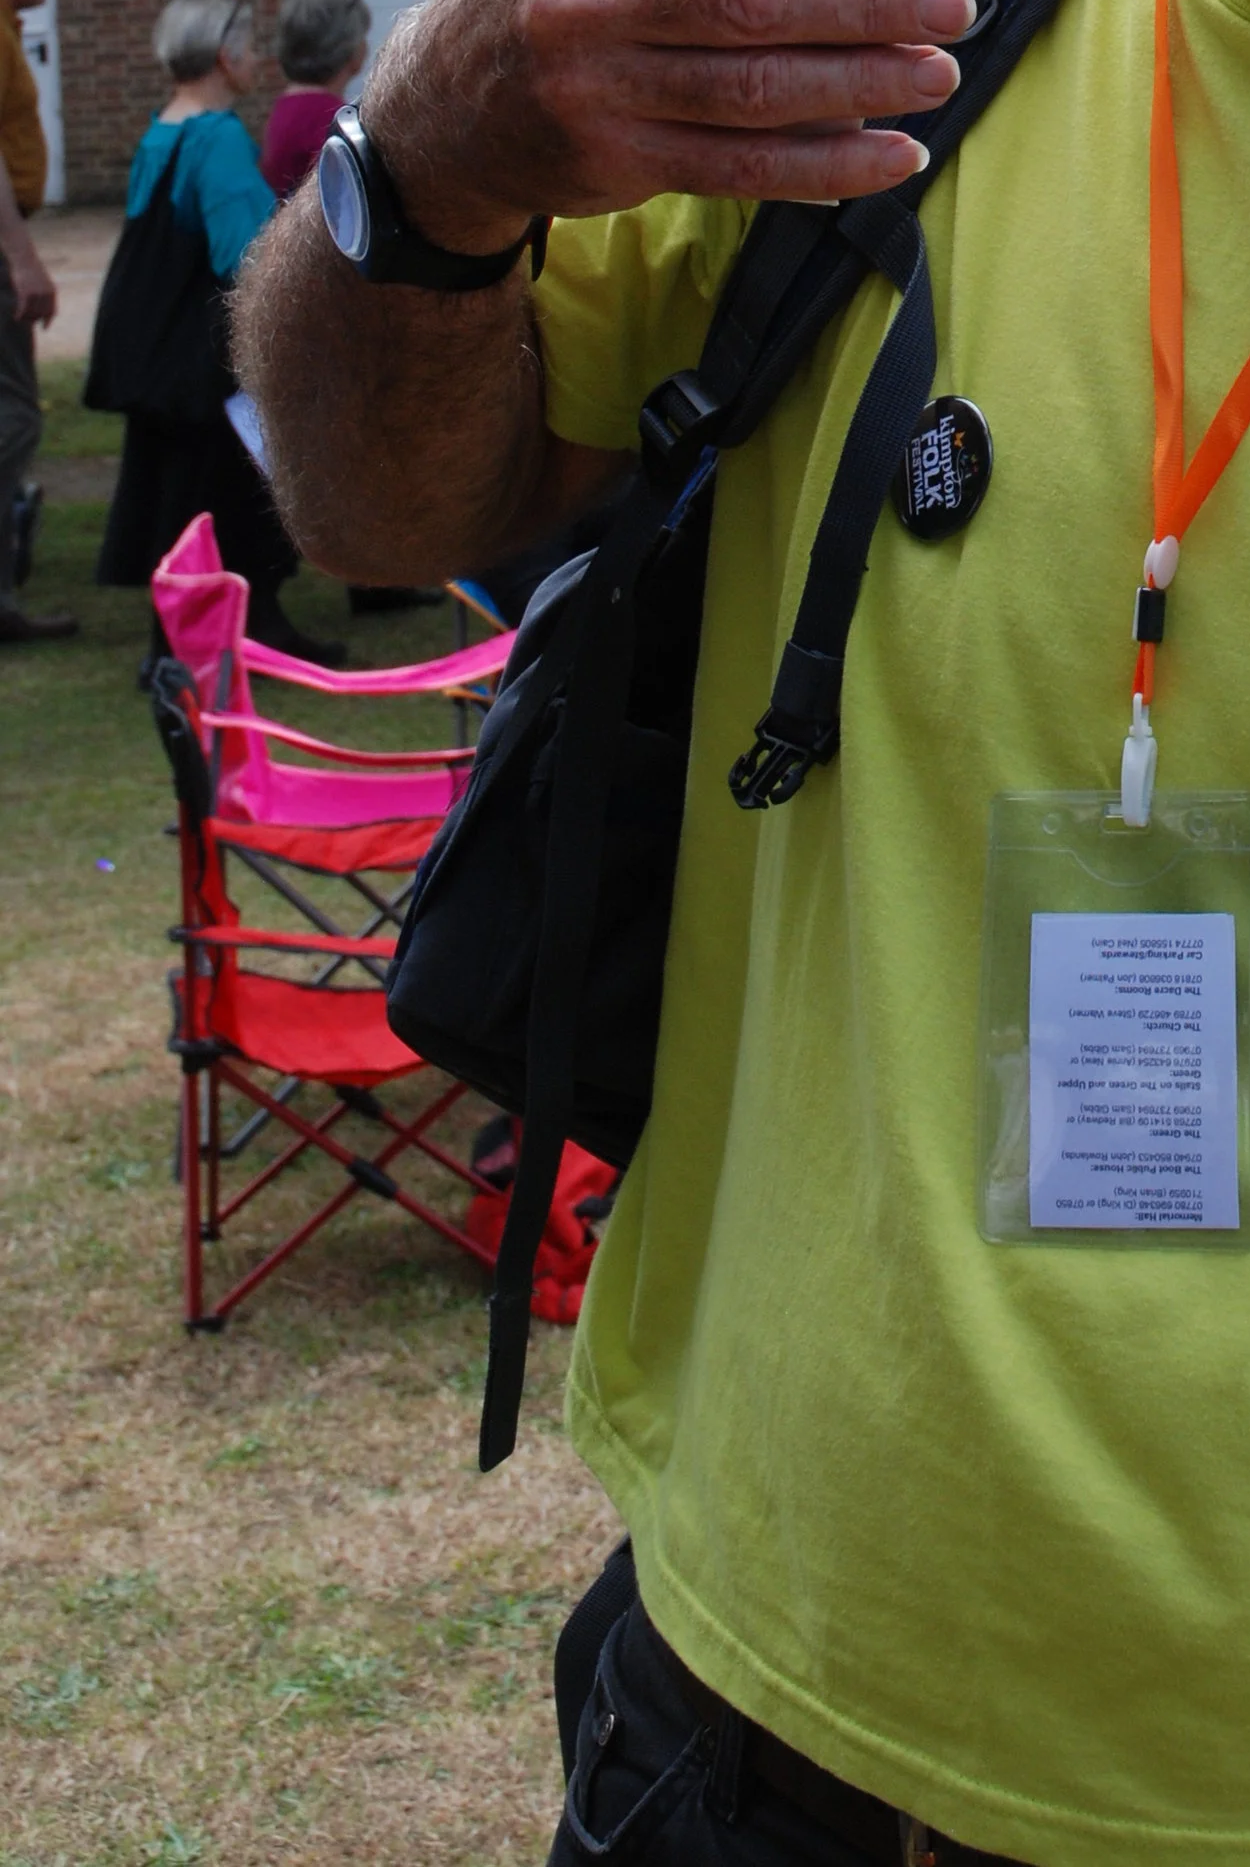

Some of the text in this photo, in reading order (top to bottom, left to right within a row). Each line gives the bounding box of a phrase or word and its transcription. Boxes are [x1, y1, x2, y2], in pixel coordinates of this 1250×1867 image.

[939, 414, 957, 508] kimpton
[922, 429, 944, 509] FOLK
[912, 438, 925, 515] FESTIVAL
[1092, 938, 1114, 947] Cain)
[1117, 938, 1137, 947] (Neil
[1176, 940, 1204, 948] 07774
[1187, 952, 1203, 960] Car
[1080, 973, 1114, 982] Palmer)
[1117, 973, 1136, 982] (Jon
[1115, 986, 1201, 995] The Dacre Rooms:
[1108, 1008, 1135, 1018] (Steve
[1142, 1022, 1201, 1031] The Church:
[1080, 1044, 1109, 1053] Gibbs)
[1112, 1044, 1135, 1054] (Sam
[1170, 1070, 1201, 1078] Green:
[1057, 1079, 1086, 1089] Upper
[1088, 1081, 1106, 1089] and
[1109, 1081, 1137, 1089] Green
[1140, 1082, 1156, 1090] The
[1175, 1082, 1201, 1090] Stalls
[1080, 1104, 1109, 1113] Gibbs)
[1112, 1104, 1135, 1114] (Sam
[1149, 1130, 1201, 1138] The Green:
[1061, 1151, 1108, 1160] Rowlands)
[1111, 1151, 1135, 1160] (John
[1091, 1165, 1201, 1174] The Boot Public House:
[1114, 1187, 1137, 1196] King)
[1140, 1188, 1166, 1197] (Brian
[1097, 1198, 1120, 1208] King)
[1124, 1199, 1136, 1208] (Di
[1134, 1213, 1202, 1222] Memorial Hall:
